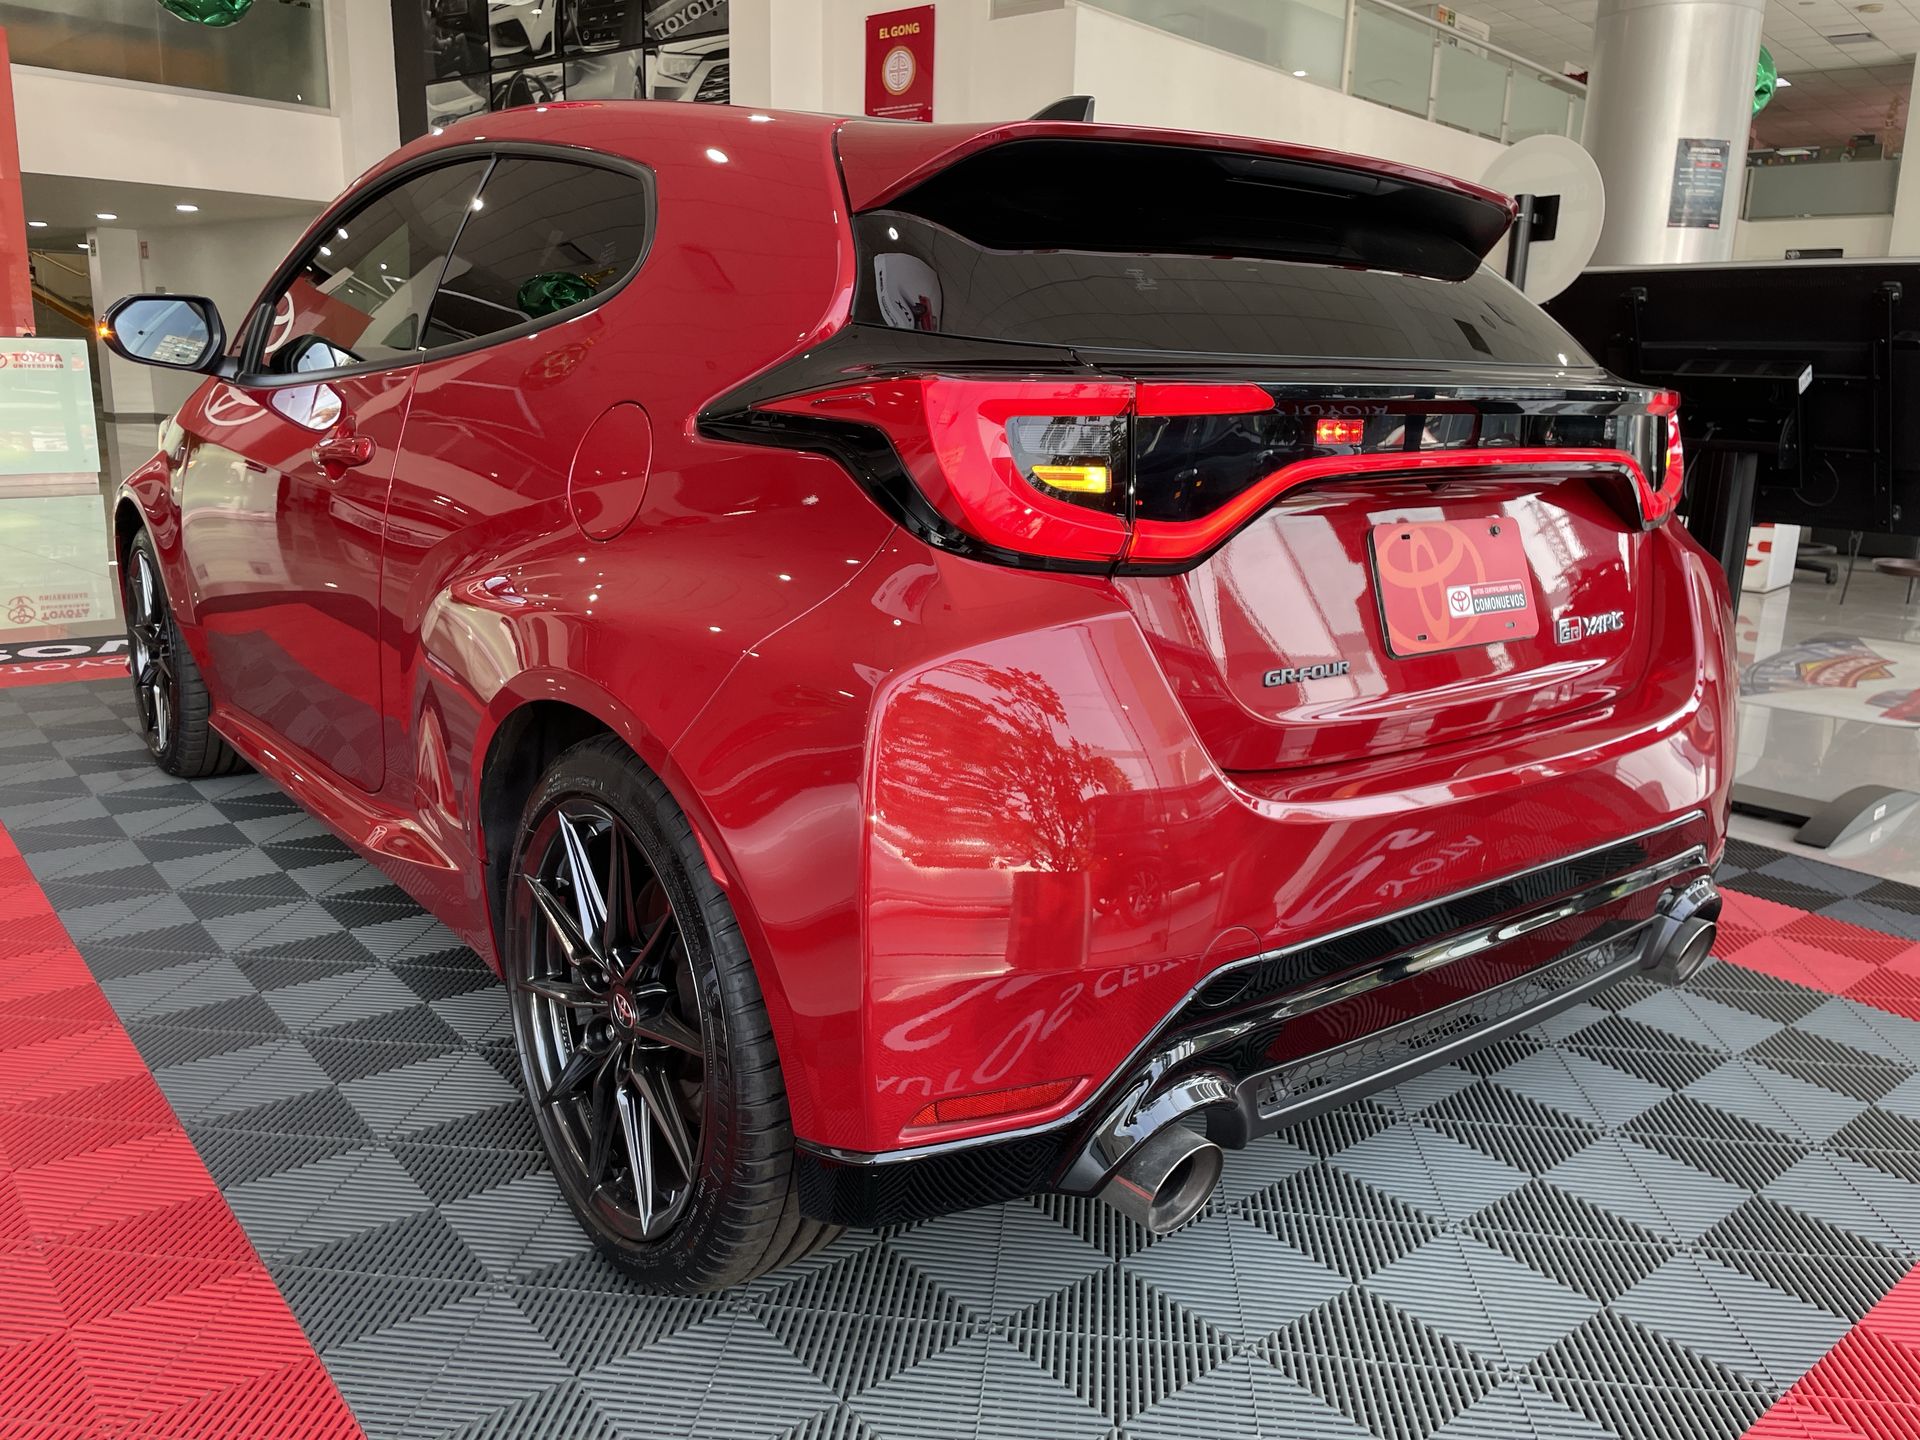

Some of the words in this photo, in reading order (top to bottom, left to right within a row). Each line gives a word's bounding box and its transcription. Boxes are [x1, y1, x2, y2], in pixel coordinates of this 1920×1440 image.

[879, 27, 891, 40] EL
[891, 22, 921, 37] GONG
[12, 353, 63, 362] TOYOTA
[1474, 594, 1525, 611] COMONUEVOS
[0, 656, 129, 674] OYOT
[1264, 661, 1350, 687] GR-FOUR
